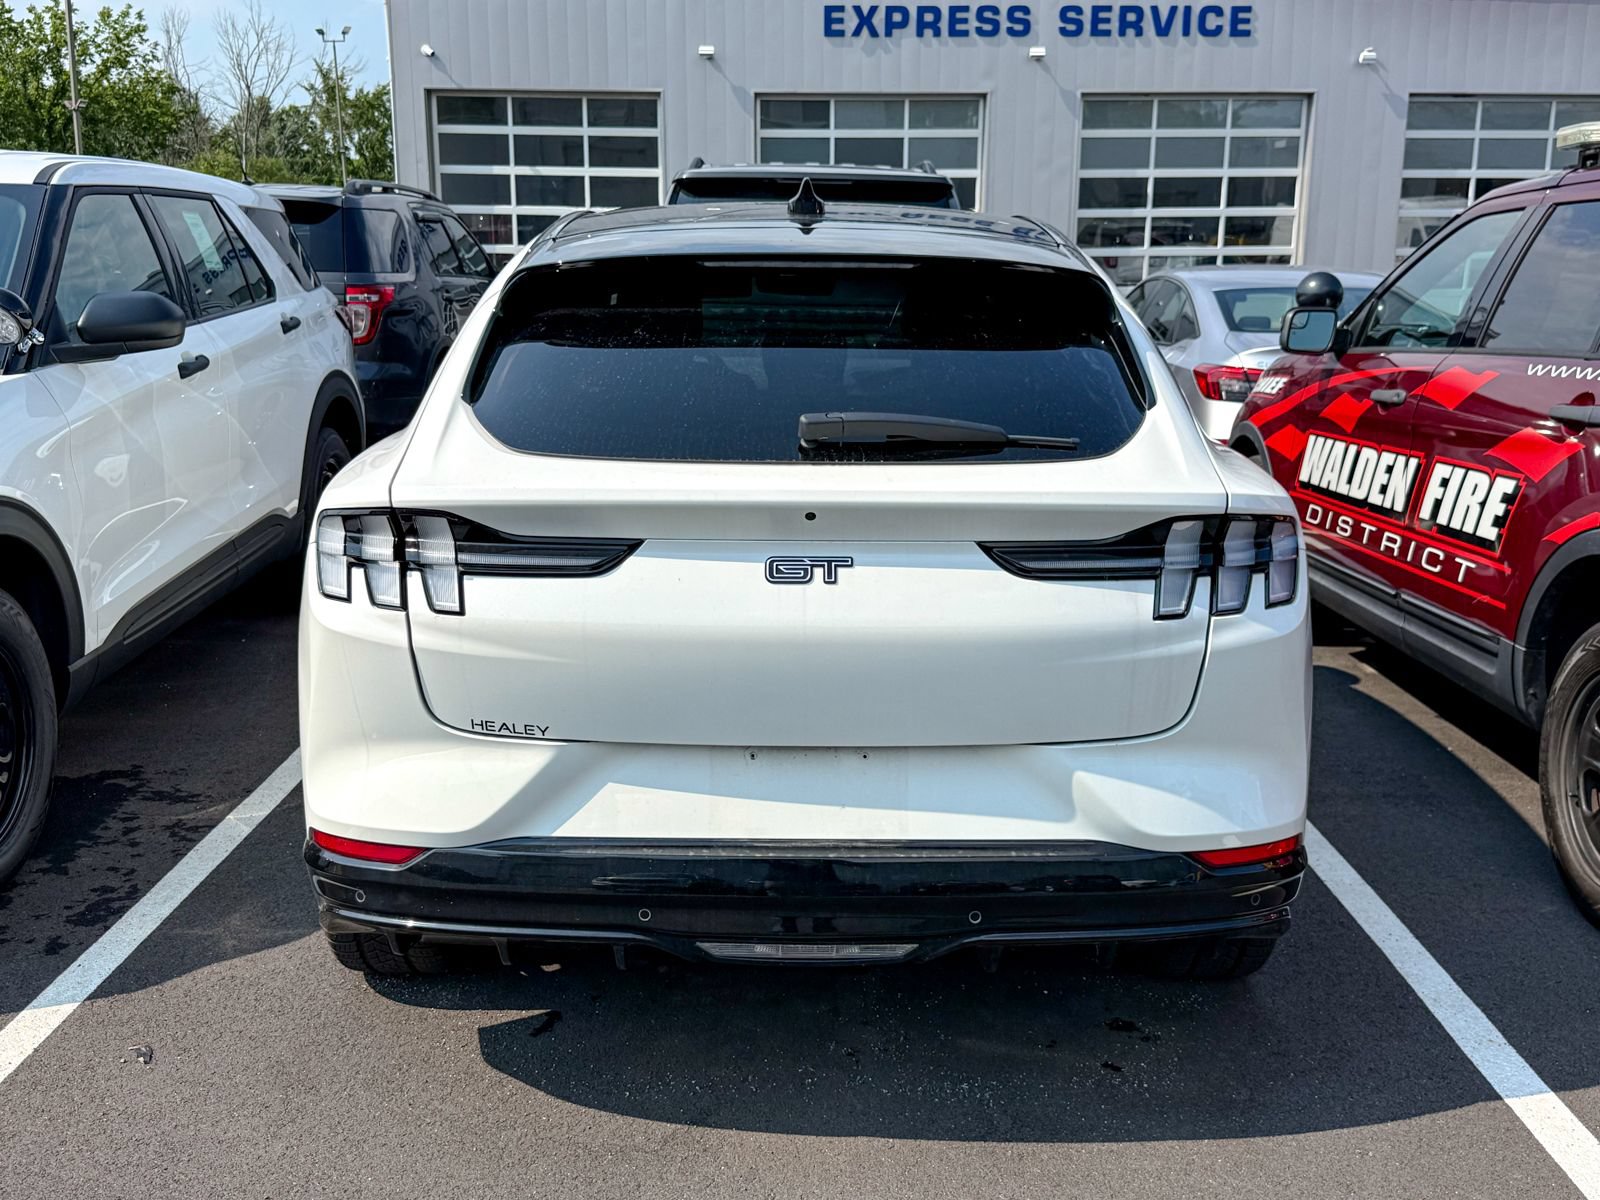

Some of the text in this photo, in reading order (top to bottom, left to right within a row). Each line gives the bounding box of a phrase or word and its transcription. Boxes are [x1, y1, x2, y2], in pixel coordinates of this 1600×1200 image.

[824, 5, 1252, 38] EXPRESS SERVICE
[1299, 434, 1518, 542] WALDEN FIRE
[1305, 503, 1477, 583] DISTRICT
[765, 556, 853, 584] GT
[470, 718, 550, 736] HEALEY
